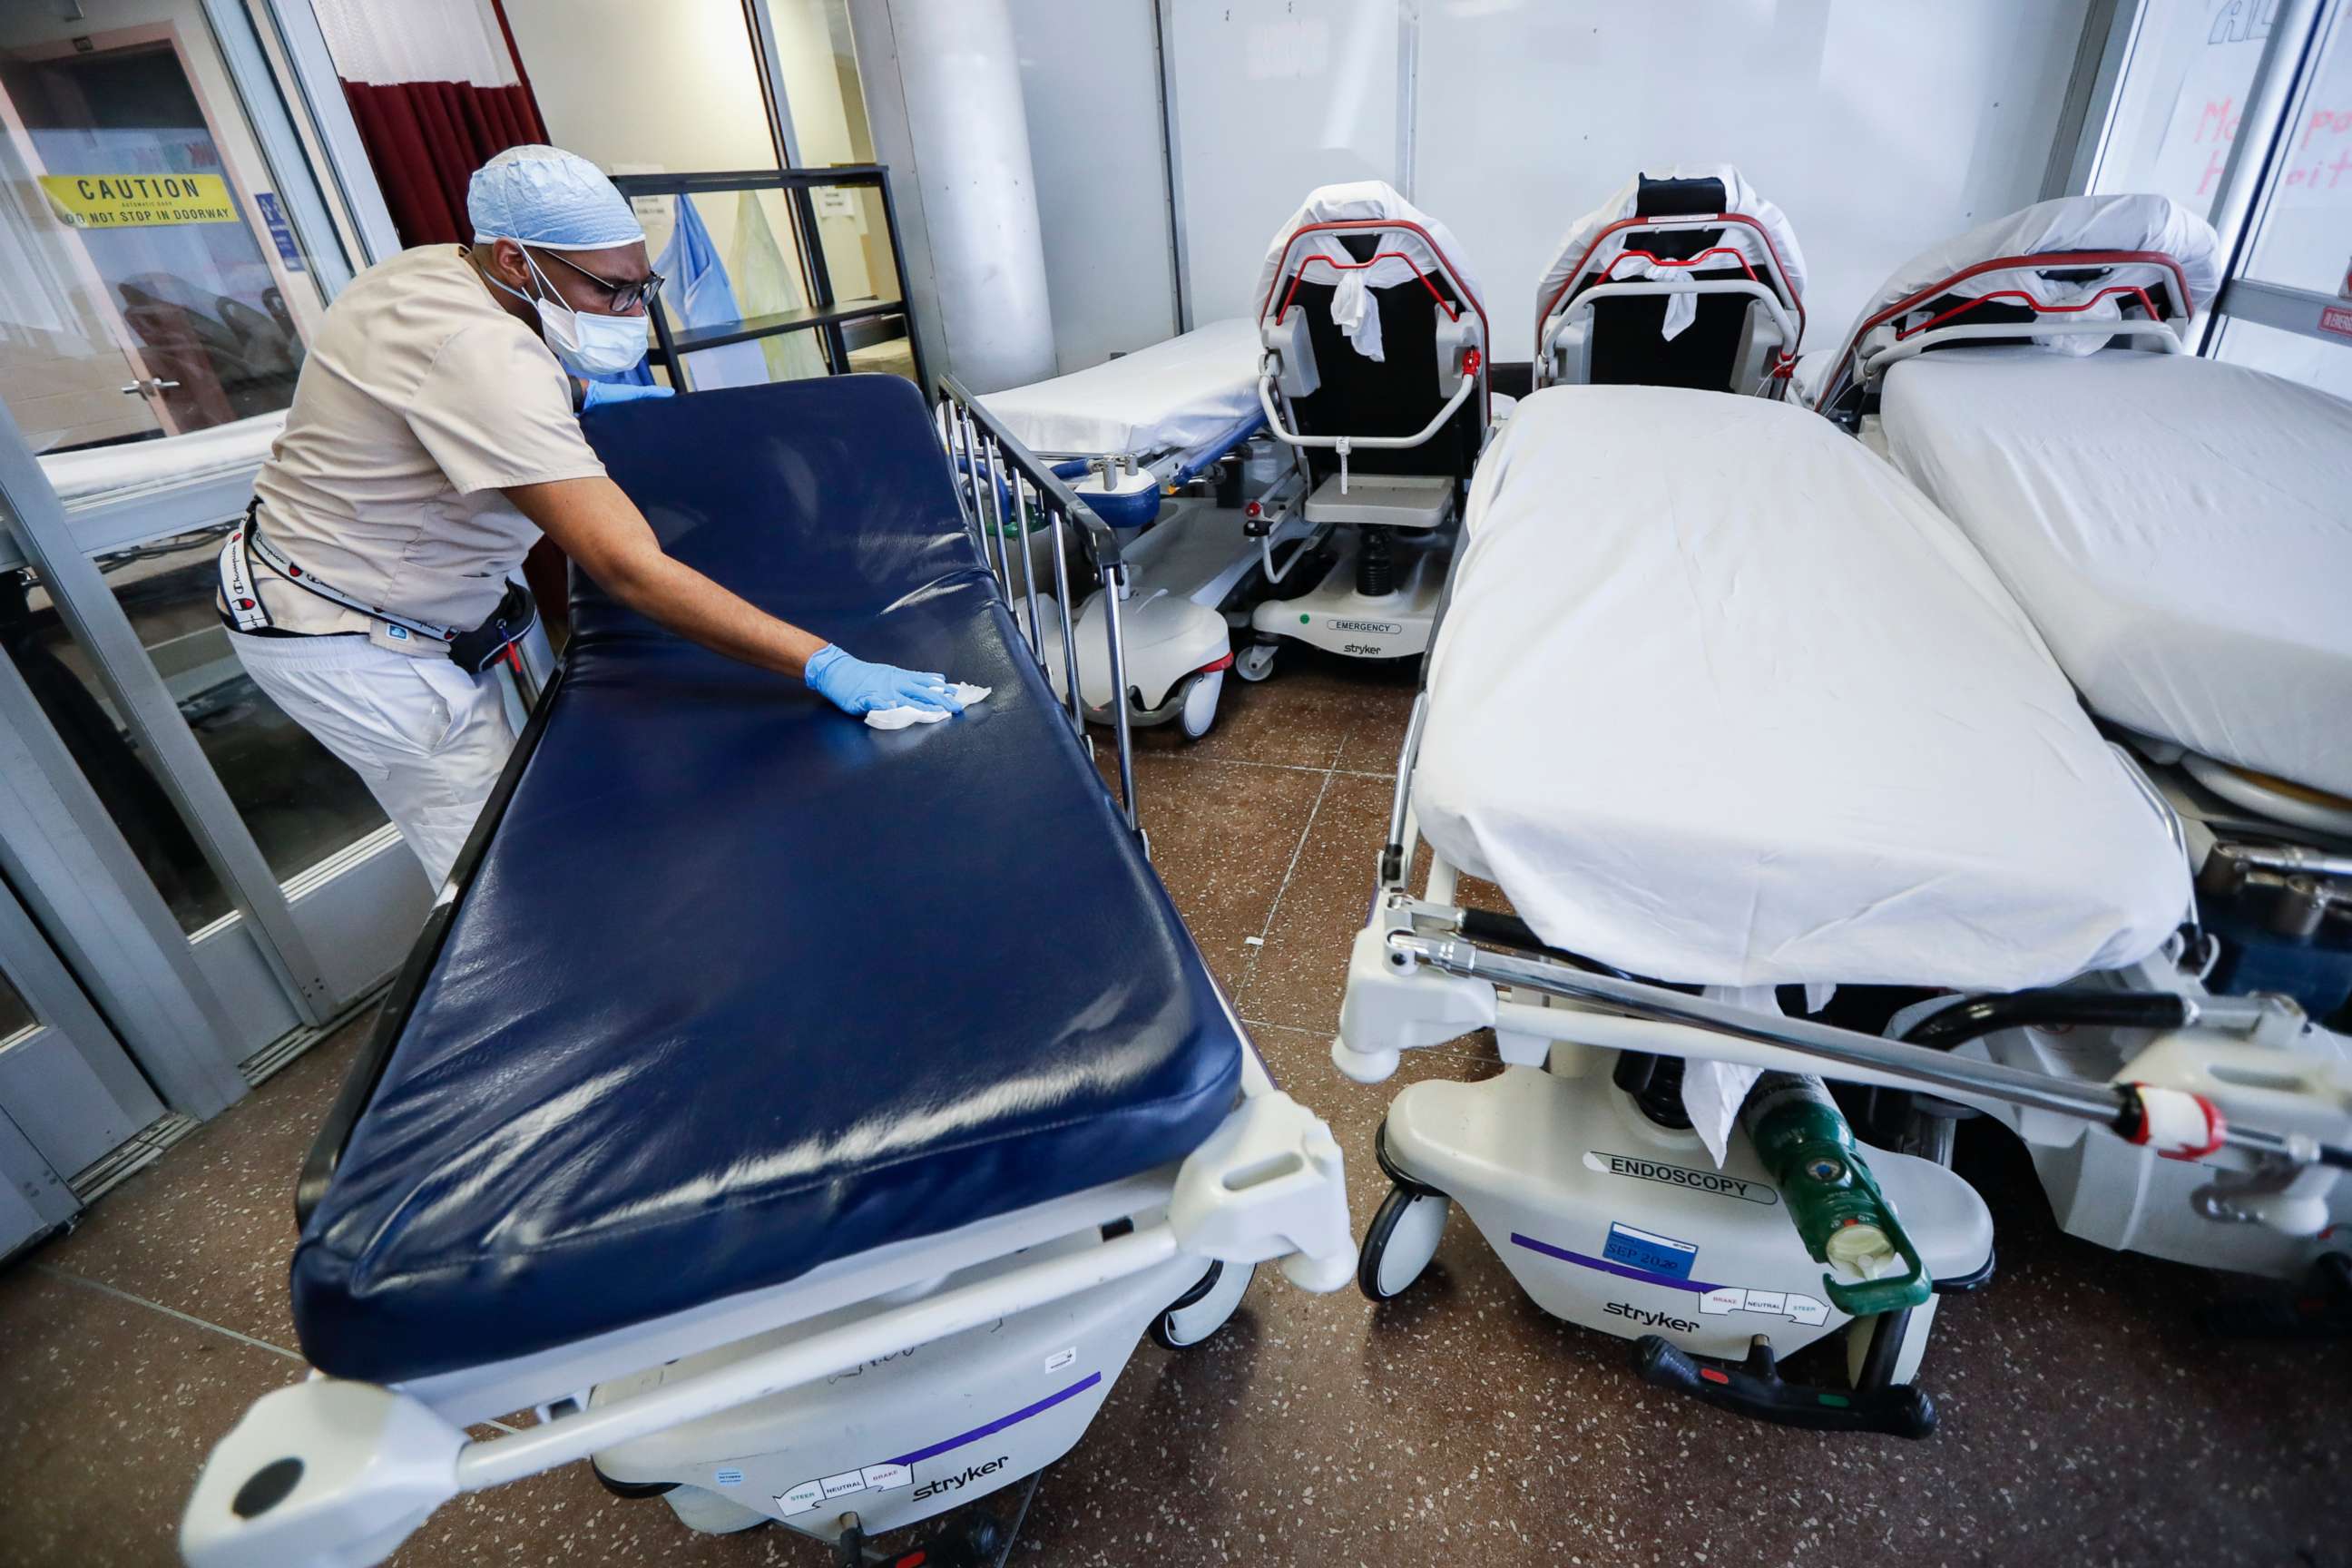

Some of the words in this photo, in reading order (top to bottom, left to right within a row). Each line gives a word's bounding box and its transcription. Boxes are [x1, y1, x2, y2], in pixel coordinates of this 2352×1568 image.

[77, 178, 200, 201] CAUTION
[65, 212, 86, 225] DO
[90, 211, 116, 223] NOT
[120, 211, 152, 221] STOP
[157, 210, 171, 220] IN
[174, 207, 230, 220] DOORWAY
[1336, 621, 1390, 632] EMERGENCY
[1343, 642, 1381, 655] stryker
[1611, 1157, 1748, 1197] ENDOSCOPY
[1607, 1243, 1638, 1259] SEP
[1712, 1296, 1738, 1305] BRAKE
[1747, 1300, 1780, 1310] NEUTRAL
[1602, 1301, 1700, 1333] stryker
[872, 1470, 898, 1481] BRAKE
[912, 1455, 1009, 1503] stryker
[826, 1481, 862, 1494] NEUTRAL
[789, 1491, 816, 1502] STEER
